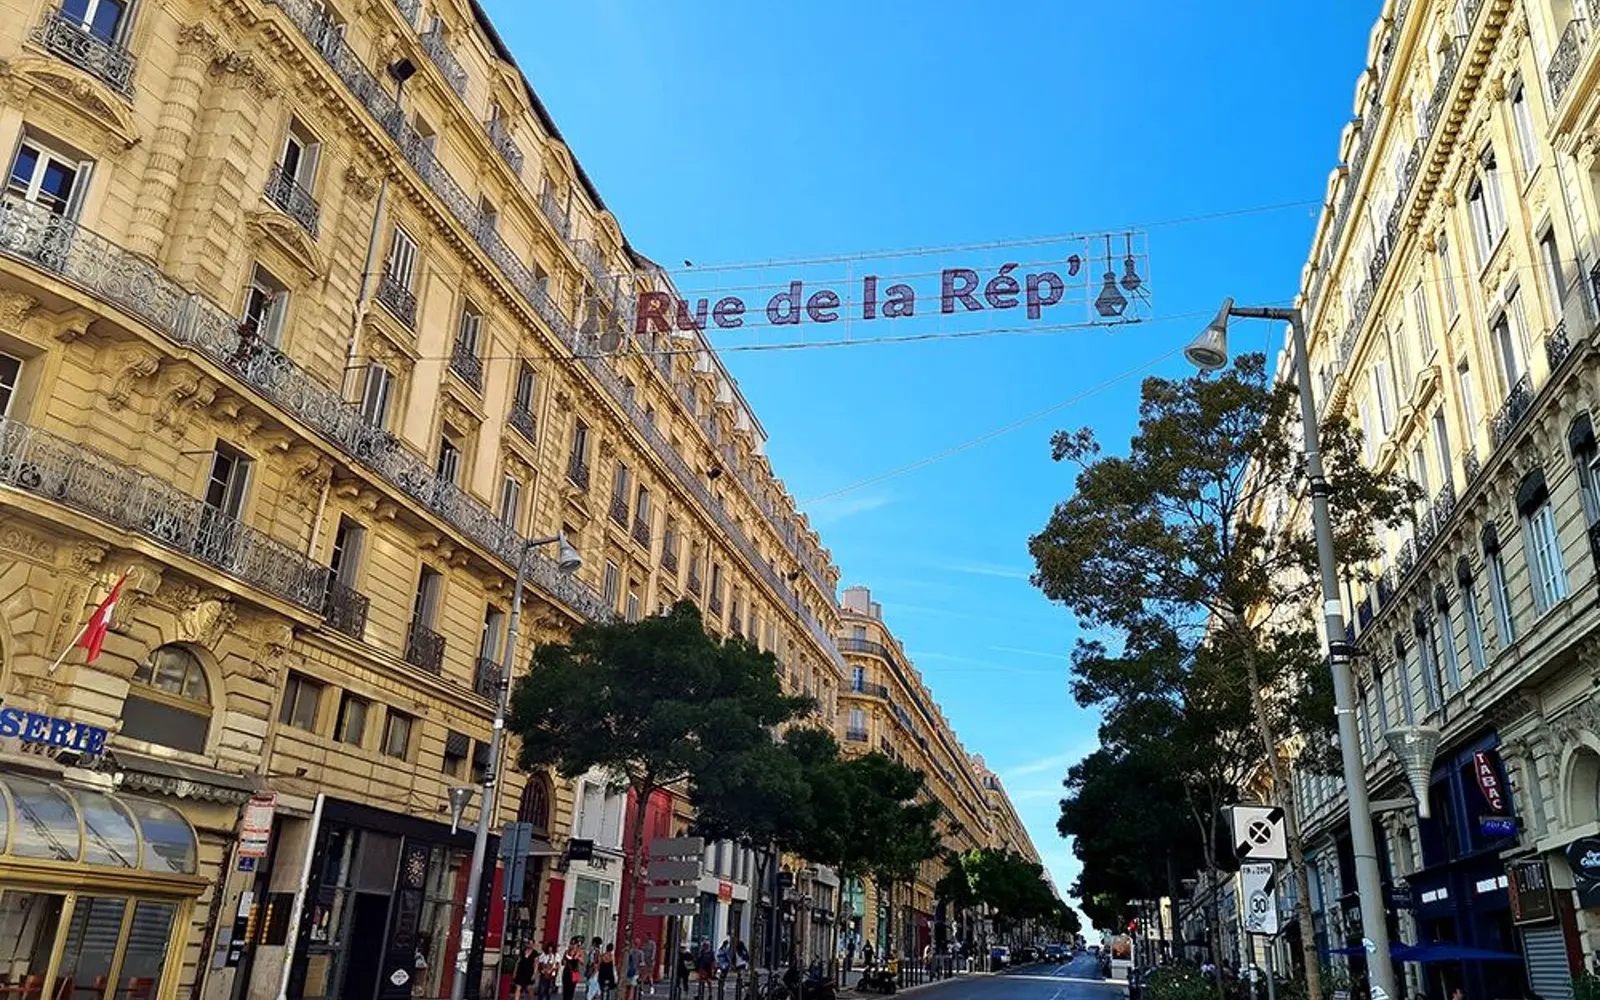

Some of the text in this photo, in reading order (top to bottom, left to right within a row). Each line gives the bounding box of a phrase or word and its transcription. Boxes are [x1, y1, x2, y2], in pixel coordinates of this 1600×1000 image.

[634, 291, 745, 334] Rue
[766, 281, 840, 325] de
[863, 276, 914, 320] la
[0, 707, 108, 754] SERIE
[1476, 752, 1503, 810] TABAC
[1252, 898, 1267, 914] 30
